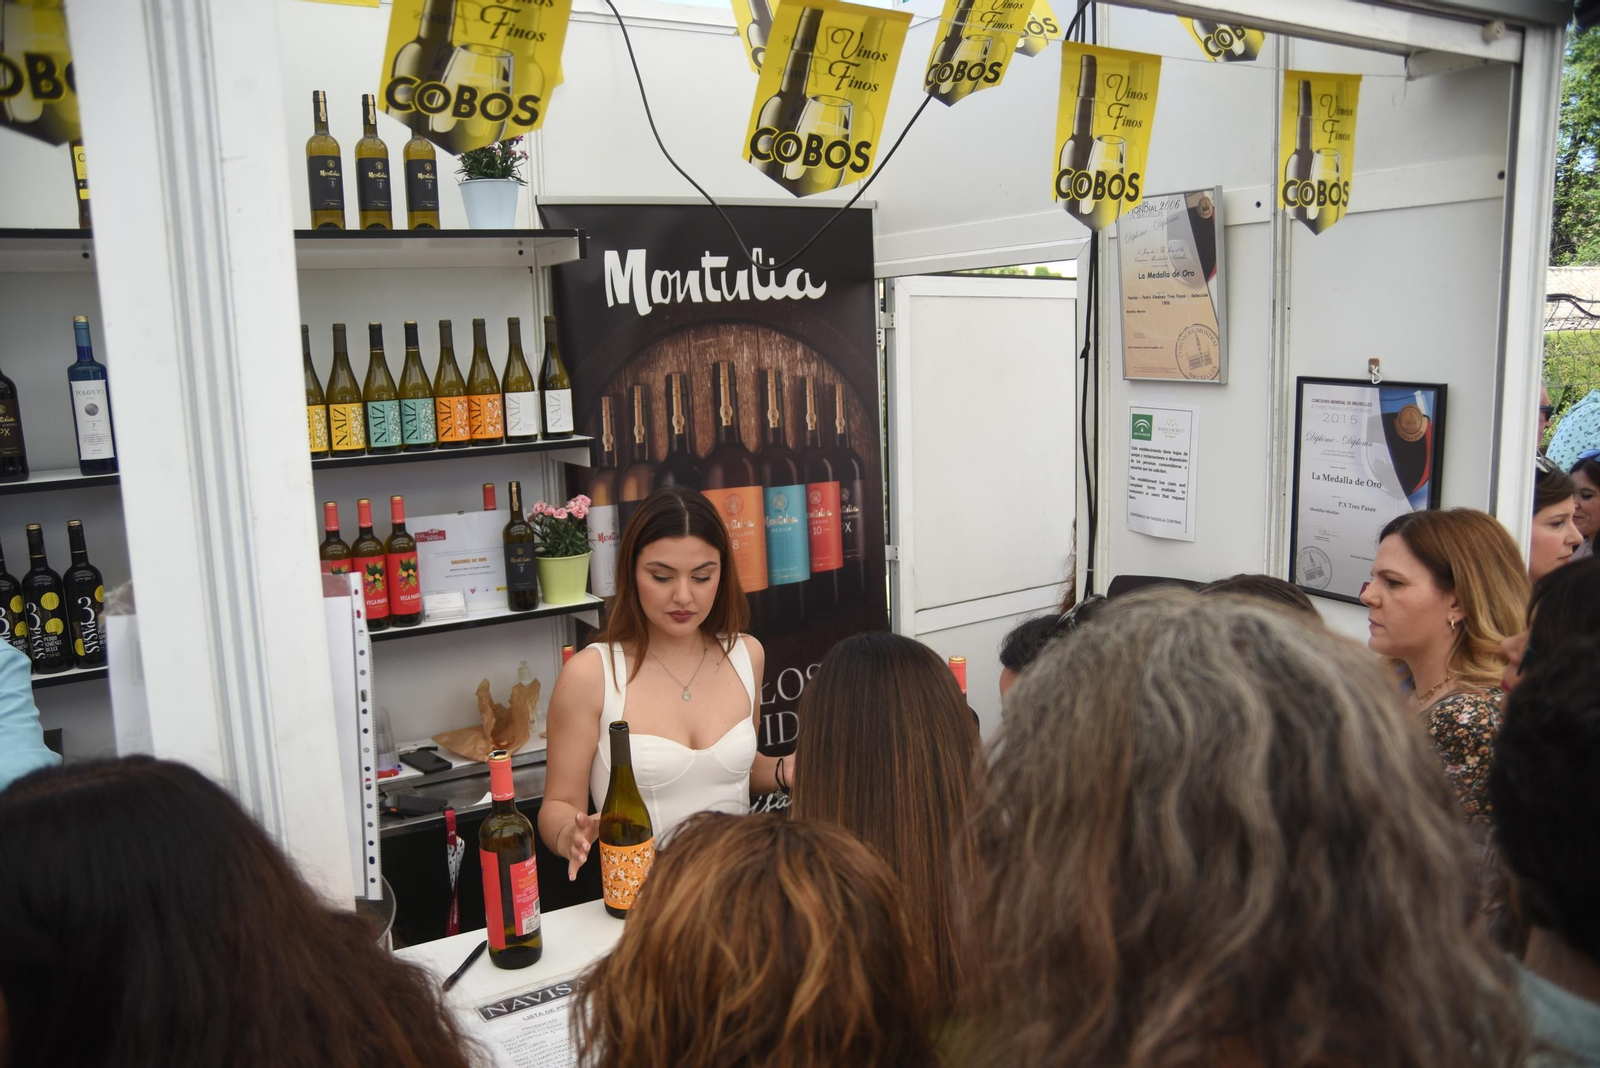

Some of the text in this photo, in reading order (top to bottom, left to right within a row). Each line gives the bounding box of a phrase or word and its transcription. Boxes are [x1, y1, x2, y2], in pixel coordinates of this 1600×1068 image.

[480, 4, 547, 42] Finos
[980, 10, 1014, 32] Finos
[831, 28, 888, 62] Vinos
[1204, 26, 1246, 57] COB
[828, 60, 880, 92] Finos
[926, 60, 1003, 86] COBOS
[386, 76, 541, 126] COBOS
[1106, 74, 1148, 101] Vinos
[1107, 102, 1142, 130] Finos
[1320, 94, 1353, 118] Vinos
[1322, 119, 1350, 144] Finos
[750, 127, 872, 174] COBOS
[1055, 168, 1140, 202] COBOS
[1282, 180, 1349, 208] COBOS
[1159, 200, 1180, 210] 2006
[604, 248, 827, 316] Montulia
[370, 404, 387, 443] NAÍZ
[402, 402, 418, 440] NAÍZ
[1322, 413, 1358, 425] 2015
[1312, 472, 1382, 489] La Medalla de Oro
[732, 540, 739, 550] 8
[813, 526, 822, 536] 10
[26, 602, 42, 630] 3
[78, 596, 96, 625] 3
[29, 627, 46, 659] PASAS
[80, 622, 100, 654] PASAS
[521, 1018, 558, 1031] PRODUCTO
[523, 1012, 545, 1021] LISTA
